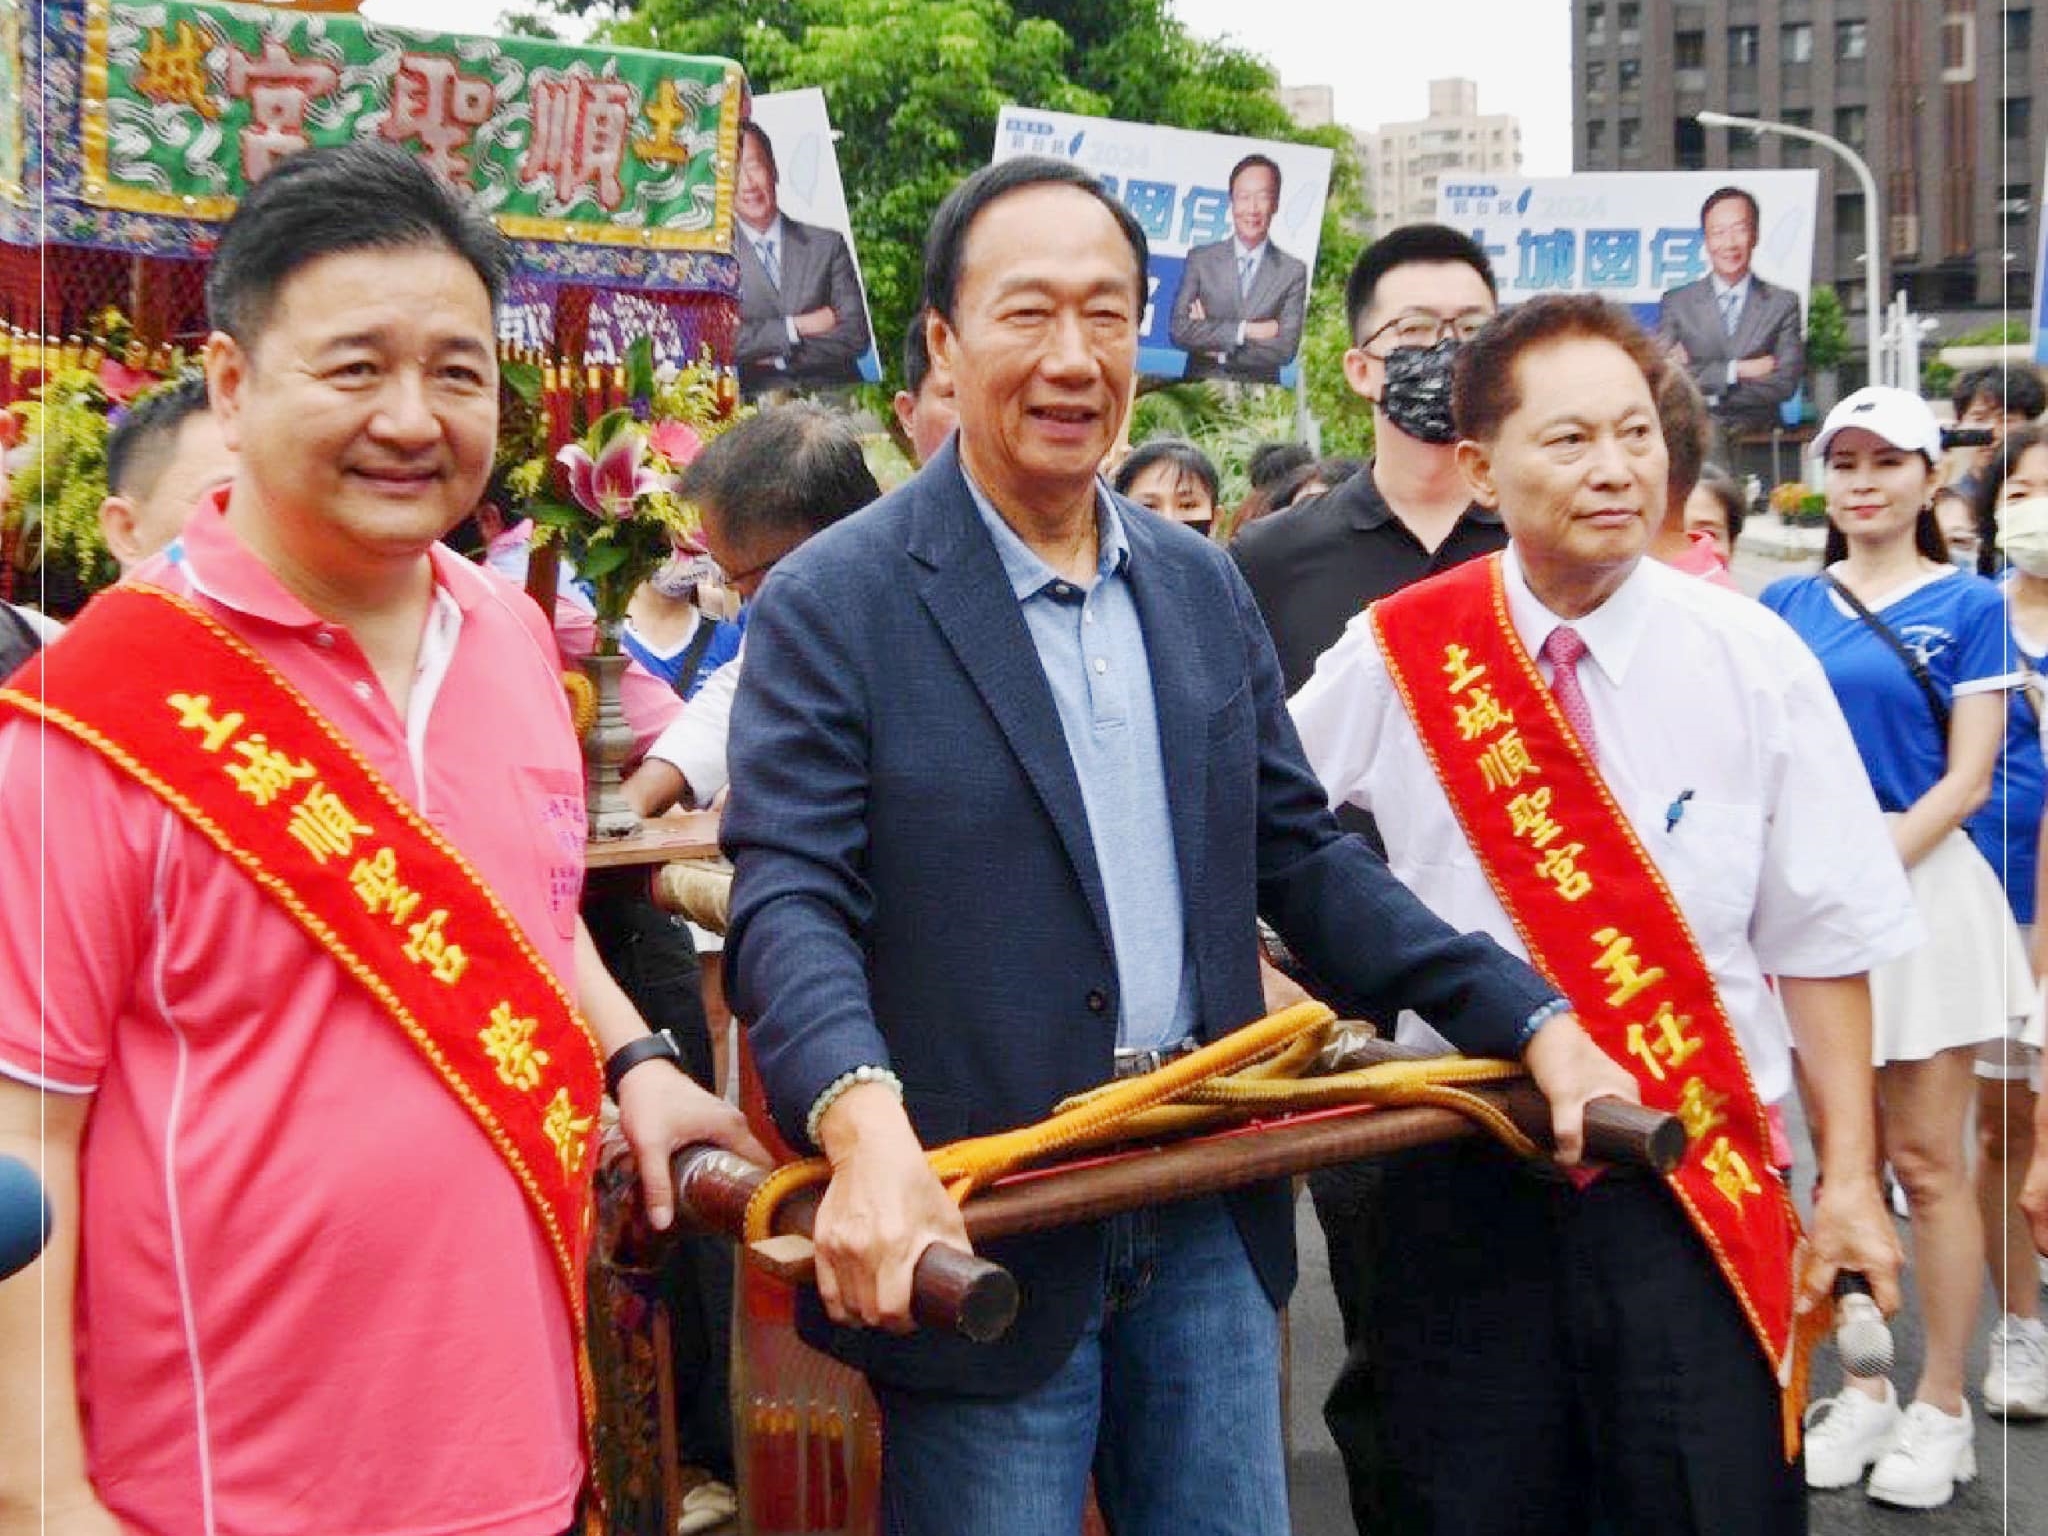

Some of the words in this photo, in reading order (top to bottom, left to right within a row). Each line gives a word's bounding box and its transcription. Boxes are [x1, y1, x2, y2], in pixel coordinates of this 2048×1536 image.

[166, 692, 470, 985] 土城順聖宮
[1442, 643, 1593, 902] 土城順聖宮
